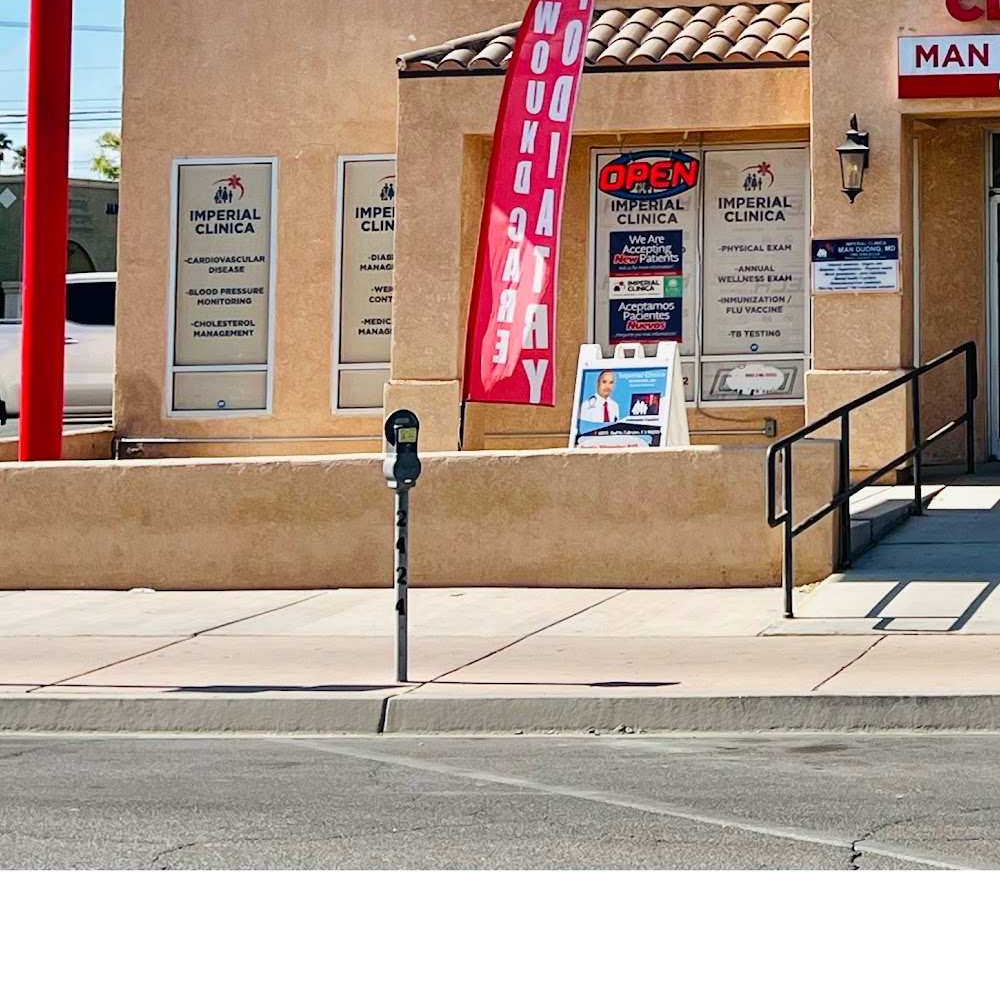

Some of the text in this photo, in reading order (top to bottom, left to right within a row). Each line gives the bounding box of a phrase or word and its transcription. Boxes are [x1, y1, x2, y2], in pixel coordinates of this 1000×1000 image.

[915, 43, 990, 69] MAN
[599, 160, 698, 191] OPEN
[611, 199, 684, 211] IMPERIAL
[718, 196, 792, 209] IMPERIAL
[190, 209, 261, 221] IMPERIAL
[355, 207, 395, 218] IMPE
[724, 210, 786, 222] CLINICA
[617, 213, 678, 224] CLINICA
[195, 223, 255, 234] CLINICA
[361, 220, 394, 231] CLIN
[629, 234, 665, 244] We Are
[622, 244, 672, 255] Accepting
[613, 253, 680, 264] New Patients
[220, 287, 264, 295] PRESSURE
[618, 302, 675, 313] Aceptamos
[623, 311, 670, 320] Pacientes
[626, 320, 666, 331] Nuevos
